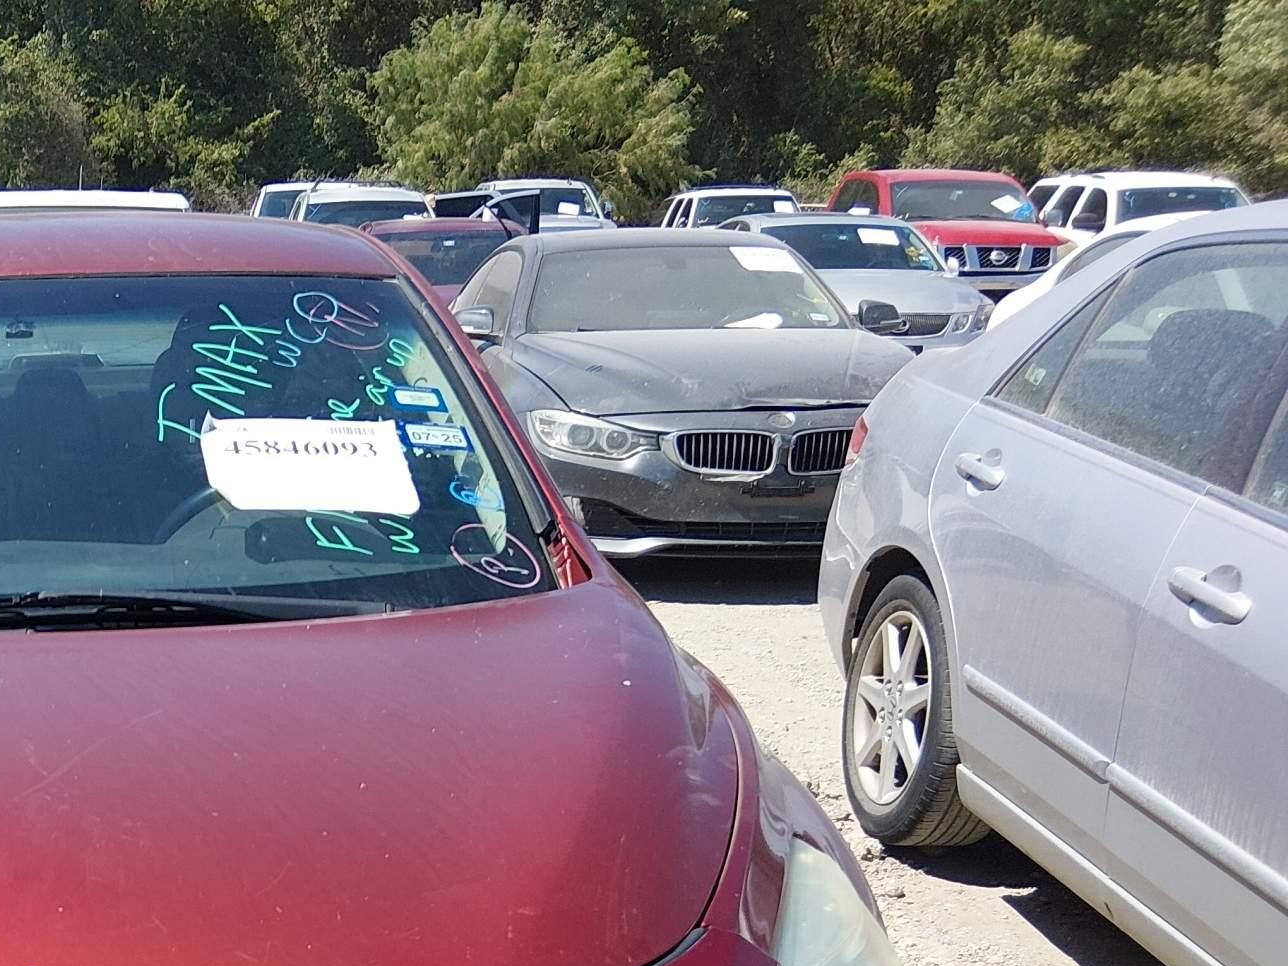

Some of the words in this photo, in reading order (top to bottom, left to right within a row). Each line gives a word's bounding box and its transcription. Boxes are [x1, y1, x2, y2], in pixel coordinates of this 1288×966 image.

[412, 431, 430, 442] 07
[441, 433, 463, 444] 25
[223, 439, 379, 458] 45846093
